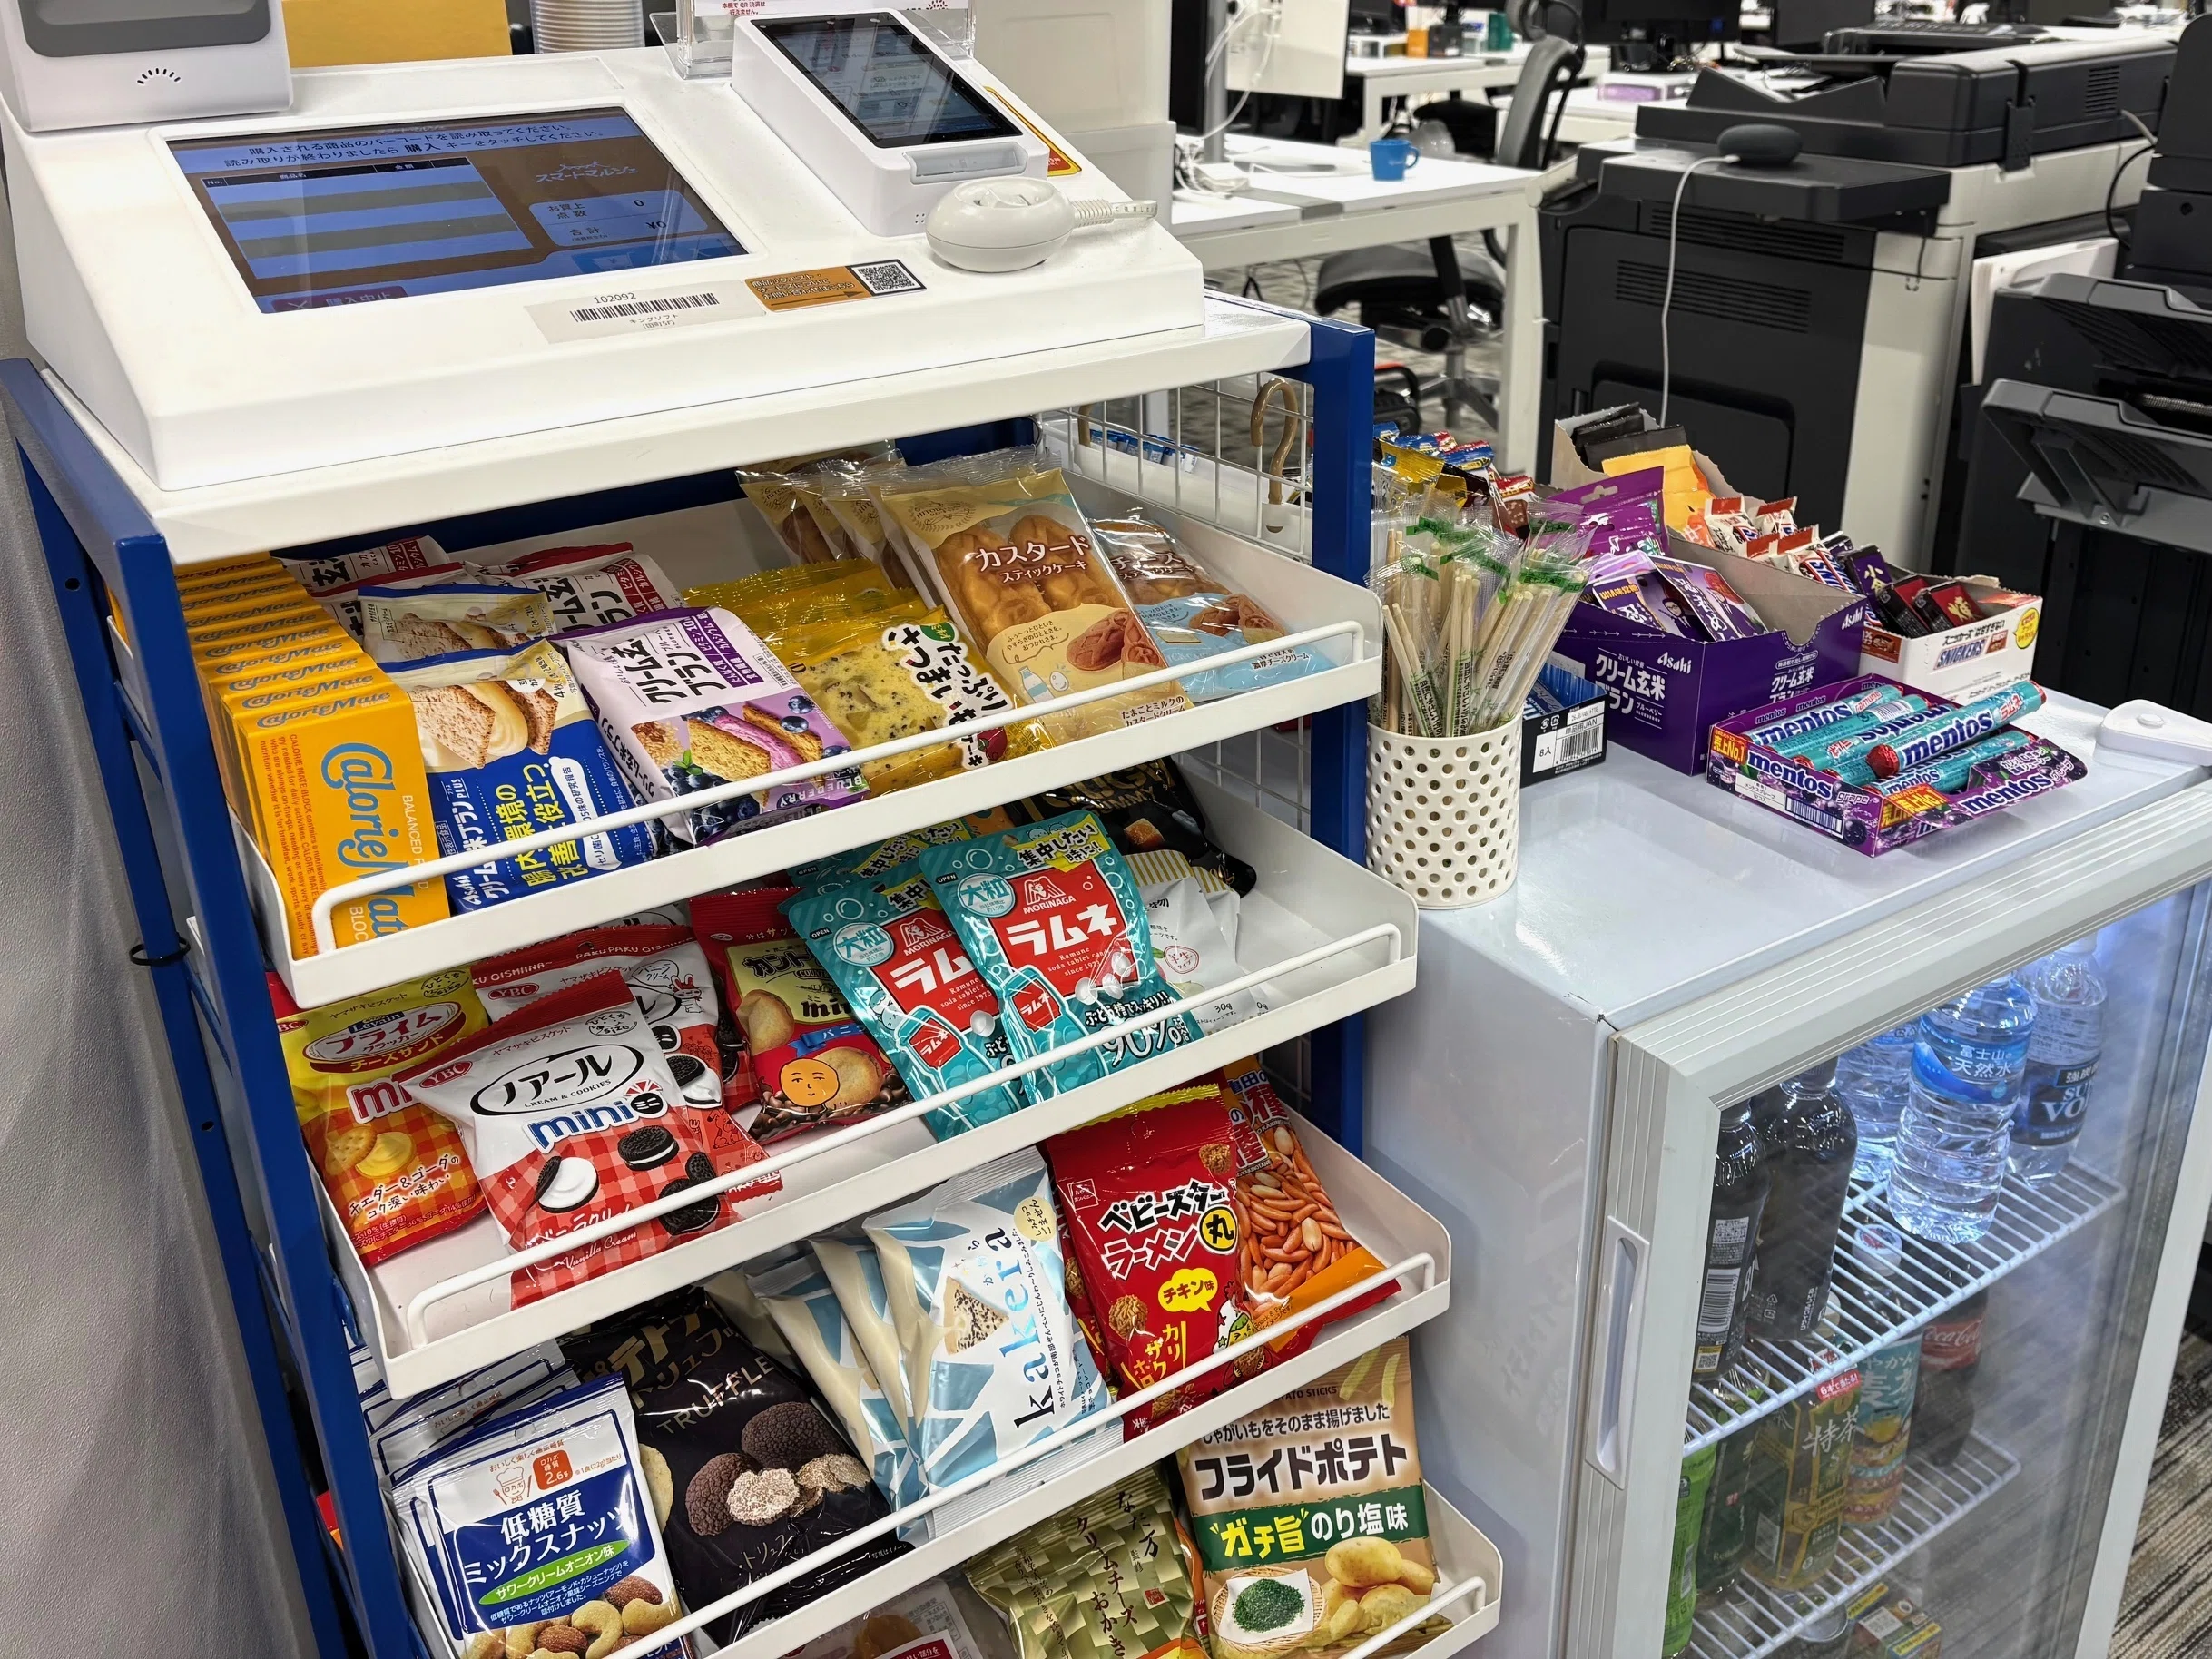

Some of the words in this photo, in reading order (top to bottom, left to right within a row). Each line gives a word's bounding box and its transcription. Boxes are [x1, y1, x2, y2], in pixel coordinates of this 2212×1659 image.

[593, 292, 637, 304] 102092
[975, 535, 1091, 572] カスタード
[999, 560, 1089, 584] スティックケーキ
[1006, 626, 1063, 652] やすらぎのひとときを。
[1022, 635, 1060, 652] おつかれさま。
[1936, 639, 1986, 668] SNICKERS
[667, 652, 727, 696] ブラン
[712, 659, 741, 684] たんぱく質
[936, 643, 1008, 711] たっぷり
[1596, 653, 1666, 701] クリーム玄米
[1657, 651, 1692, 674] Asahi
[1771, 666, 1815, 693] クリーム玄米
[1121, 696, 1185, 720] たまごとミルクの
[1636, 702, 1663, 717] ブルーベリー
[1755, 708, 1787, 724] mentos
[1795, 695, 1826, 712] mentos
[1756, 702, 1854, 747] mentos
[1901, 709, 1995, 768] mentos
[289, 733, 303, 766] CALORIE
[1539, 746, 1552, 757] 8入
[296, 767, 307, 788] MATE
[456, 778, 467, 799] PLUS
[779, 774, 863, 809] BLUEBERRY
[1746, 750, 1834, 800] mentos
[1835, 790, 1870, 805] grape
[300, 789, 312, 813] BLOCK
[1959, 771, 2056, 815] mentos
[305, 814, 318, 843] contains
[402, 795, 423, 855] BALANCED
[301, 842, 314, 874] CALORIE
[1017, 822, 1098, 869] 集中したい
[1066, 841, 1103, 864] 時に!
[937, 874, 958, 884] OPEN
[960, 877, 1007, 907] 大粒
[1023, 895, 1077, 915] MORINAGA
[349, 906, 369, 943] BLOC
[811, 928, 831, 938] OPEN
[1005, 903, 1118, 956] ラムネ
[607, 943, 639, 955] PAKU
[839, 927, 889, 957] 大粒
[904, 929, 953, 957] MORINAGA
[1058, 947, 1091, 961] Ramune
[637, 963, 672, 977] バニラ
[645, 970, 671, 982] クリーム
[1047, 963, 1066, 973] soda
[1067, 953, 1090, 967] tablet
[1064, 967, 1084, 977] since
[1085, 960, 1101, 972] 1973
[493, 983, 535, 998] YBC
[940, 996, 957, 1008] soda
[958, 985, 983, 1003] tablet
[949, 977, 980, 995] Ramune
[957, 999, 975, 1011] since
[976, 990, 994, 1004] 1973
[329, 992, 408, 1020] ヤマザキビスケット
[1214, 1002, 1234, 1014] 30g
[326, 1011, 445, 1055] プライム
[350, 1011, 404, 1032] Levain
[350, 1034, 445, 1071] チーズサンド
[362, 1030, 419, 1054] クラッカー
[493, 1026, 572, 1056] ヤマザキビスケット
[1959, 1044, 2013, 1061] 富士山の
[425, 1061, 468, 1086] YBC
[502, 1055, 614, 1108] ノアール
[1952, 1058, 2013, 1079] 天然水
[524, 1098, 559, 1108] CREAM
[561, 1093, 568, 1101] &
[570, 1078, 612, 1098] COOKIES
[531, 1101, 635, 1146] mini
[349, 1153, 459, 1215] チェダー&ゴーダの
[367, 1173, 451, 1220] コク深い味わい
[1098, 1180, 1229, 1232] ベビースター
[1206, 1214, 1234, 1244] 丸
[564, 1244, 603, 1270] Vanilla
[604, 1232, 638, 1250] Cream
[1104, 1225, 1200, 1281] ラーメン
[1161, 1278, 1216, 1304] チキン味
[984, 1227, 1057, 1429] kakera
[1163, 1324, 1181, 1361] カリ
[656, 1355, 775, 1436] TRUFFLE
[1305, 1386, 1337, 1397] STICKS
[1203, 1403, 1391, 1445] じゃがいもをそのまま揚げました
[1802, 1404, 1860, 1458] 特茶
[488, 1439, 565, 1473] おいしく楽しく適正糖質
[540, 1454, 560, 1466] ロカボ
[544, 1462, 559, 1471] 糖質
[1194, 1433, 1408, 1502] フライドポテト
[505, 1482, 524, 1493] ロカボ
[546, 1471, 569, 1486] 2.6g
[500, 1489, 585, 1546] 低糖質
[1116, 1491, 1159, 1558] なだ万
[464, 1506, 637, 1585] ミックスナッツ
[496, 1545, 615, 1601] サワークリームオニオン味
[1077, 1517, 1138, 1628] クリームチーズ
[490, 1561, 629, 1622] 低糖質であるナッツ(アーモンド・カシューナッツ)を
[501, 1570, 623, 1625] サワークリームオニオン風味シーズニングで
[541, 1595, 588, 1616] 味付けしました。
[1090, 1591, 1126, 1658] おかき
